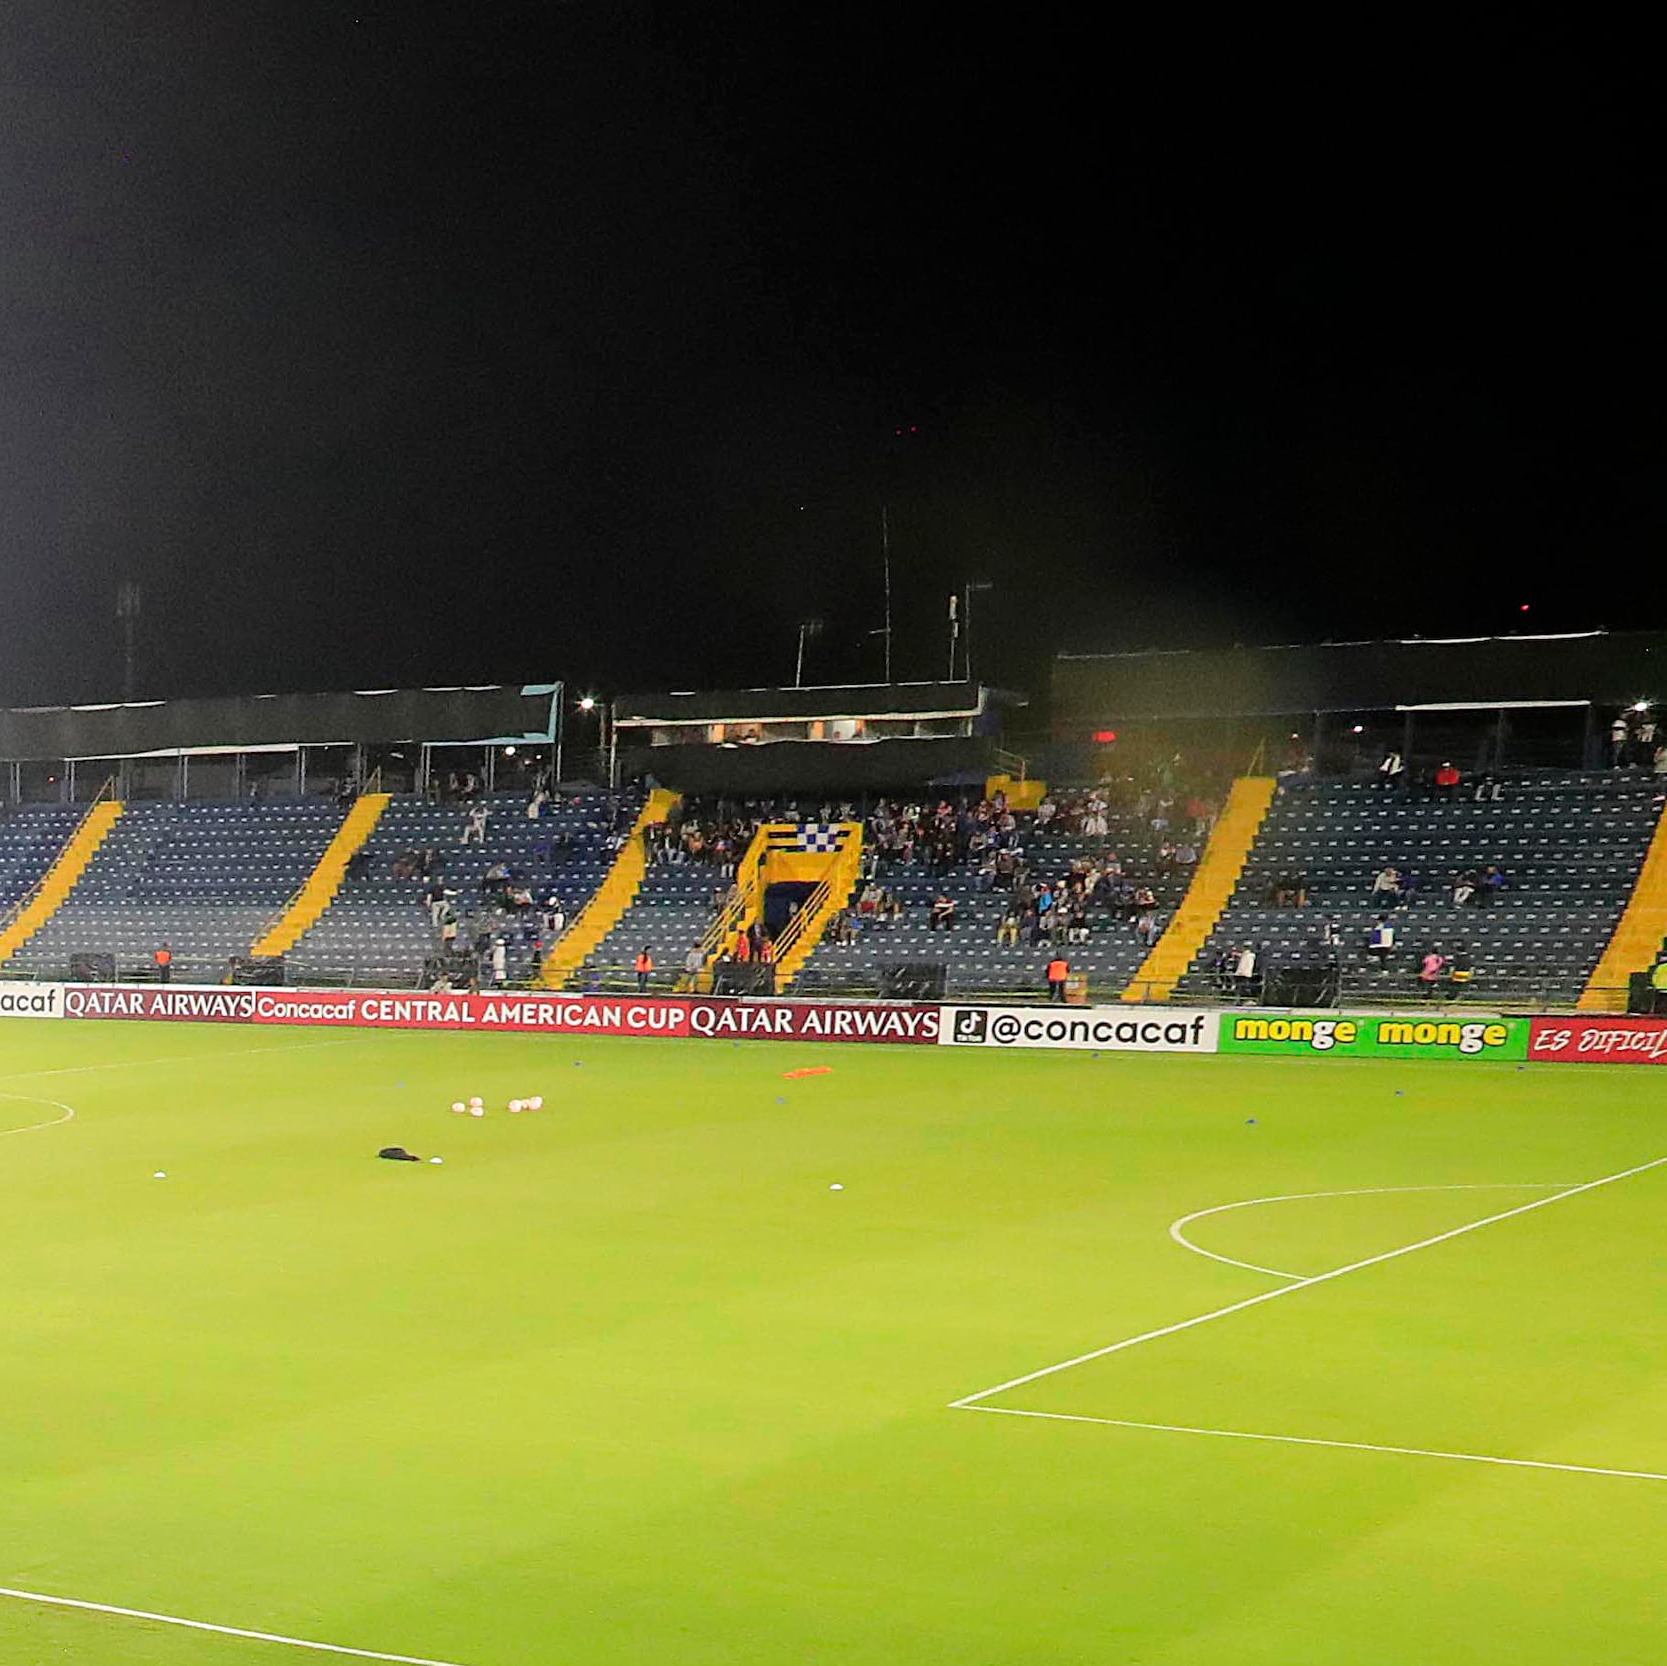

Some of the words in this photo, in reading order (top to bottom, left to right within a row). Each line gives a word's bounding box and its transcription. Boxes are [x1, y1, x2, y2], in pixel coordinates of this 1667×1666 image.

[65, 992, 144, 1017] QATAR
[149, 993, 253, 1017] AIRWAYS
[257, 997, 356, 1020] Concacaf
[361, 999, 475, 1023] CENTRAL
[481, 1002, 622, 1027] AMERICAN
[627, 1006, 685, 1030] CUP
[689, 1005, 793, 1036] QATAR
[800, 1009, 939, 1038] AIRWAYS
[991, 1015, 1205, 1045] @concacaf
[1235, 1018, 1357, 1051] monge
[1378, 1020, 1507, 1053] monge
[1534, 1029, 1572, 1051] ES
